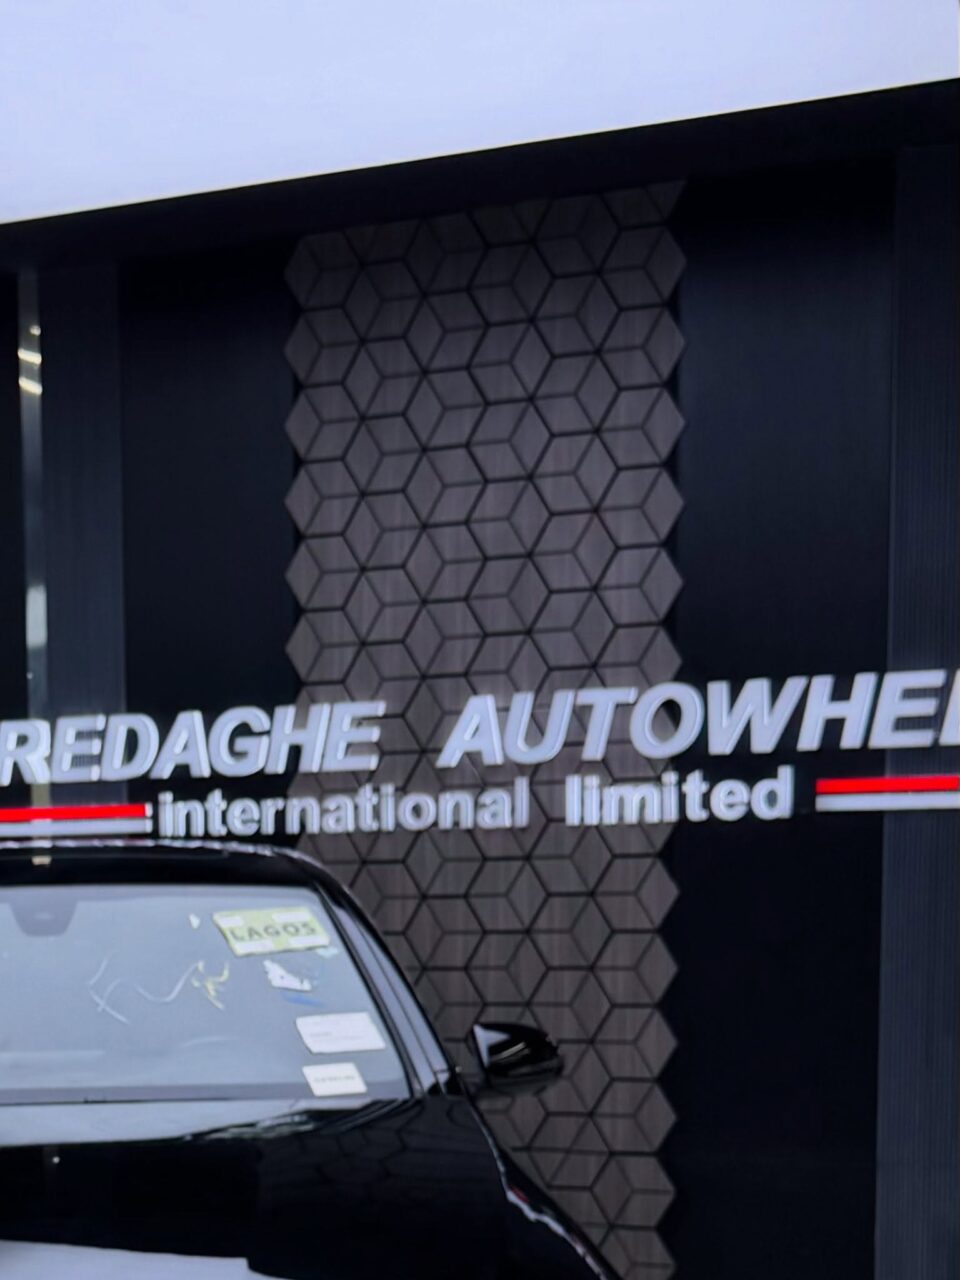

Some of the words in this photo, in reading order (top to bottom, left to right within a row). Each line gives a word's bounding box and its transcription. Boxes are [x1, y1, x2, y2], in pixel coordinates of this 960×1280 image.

[158, 777, 529, 837] international
[564, 764, 795, 828] limited
[230, 922, 316, 940] LAGOS
